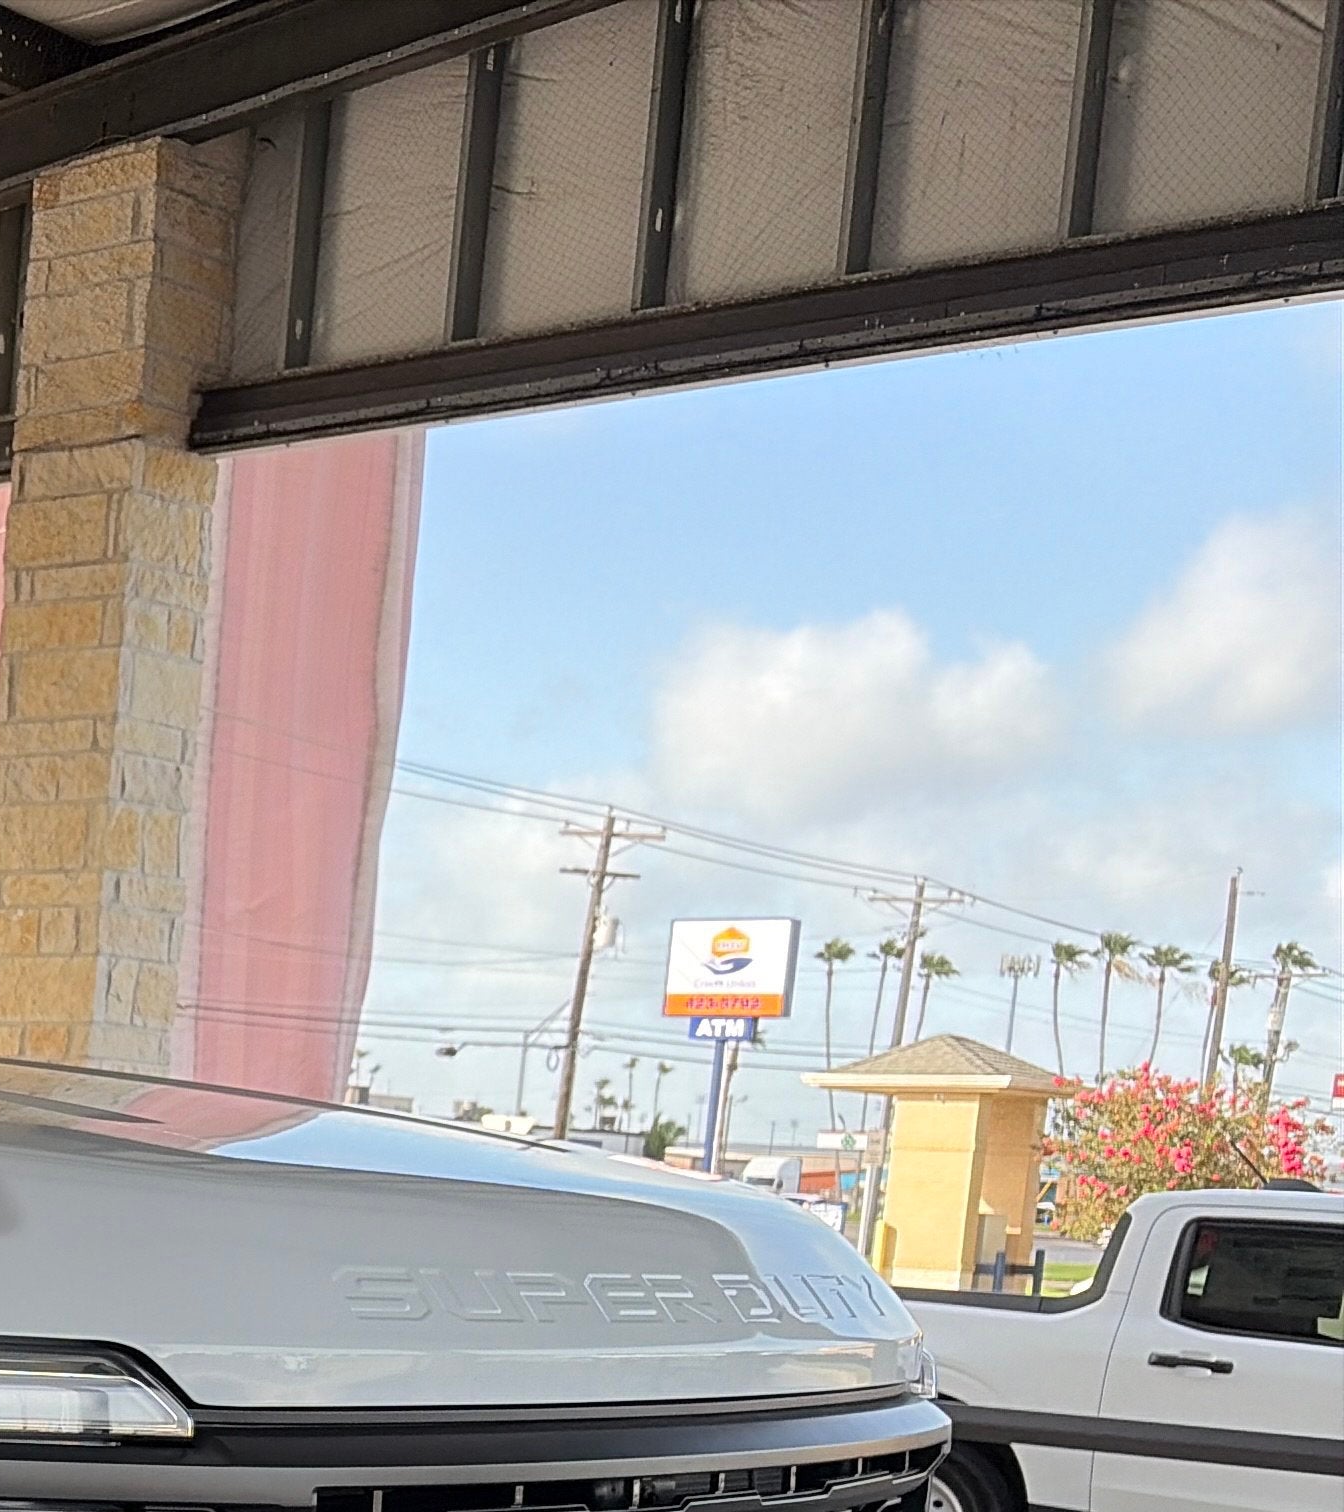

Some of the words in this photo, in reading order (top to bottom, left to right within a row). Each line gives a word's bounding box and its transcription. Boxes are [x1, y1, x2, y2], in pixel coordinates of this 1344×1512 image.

[695, 1018, 745, 1037] ATM
[333, 1266, 720, 1324] SUPER
[715, 1273, 886, 1324] DUTY
